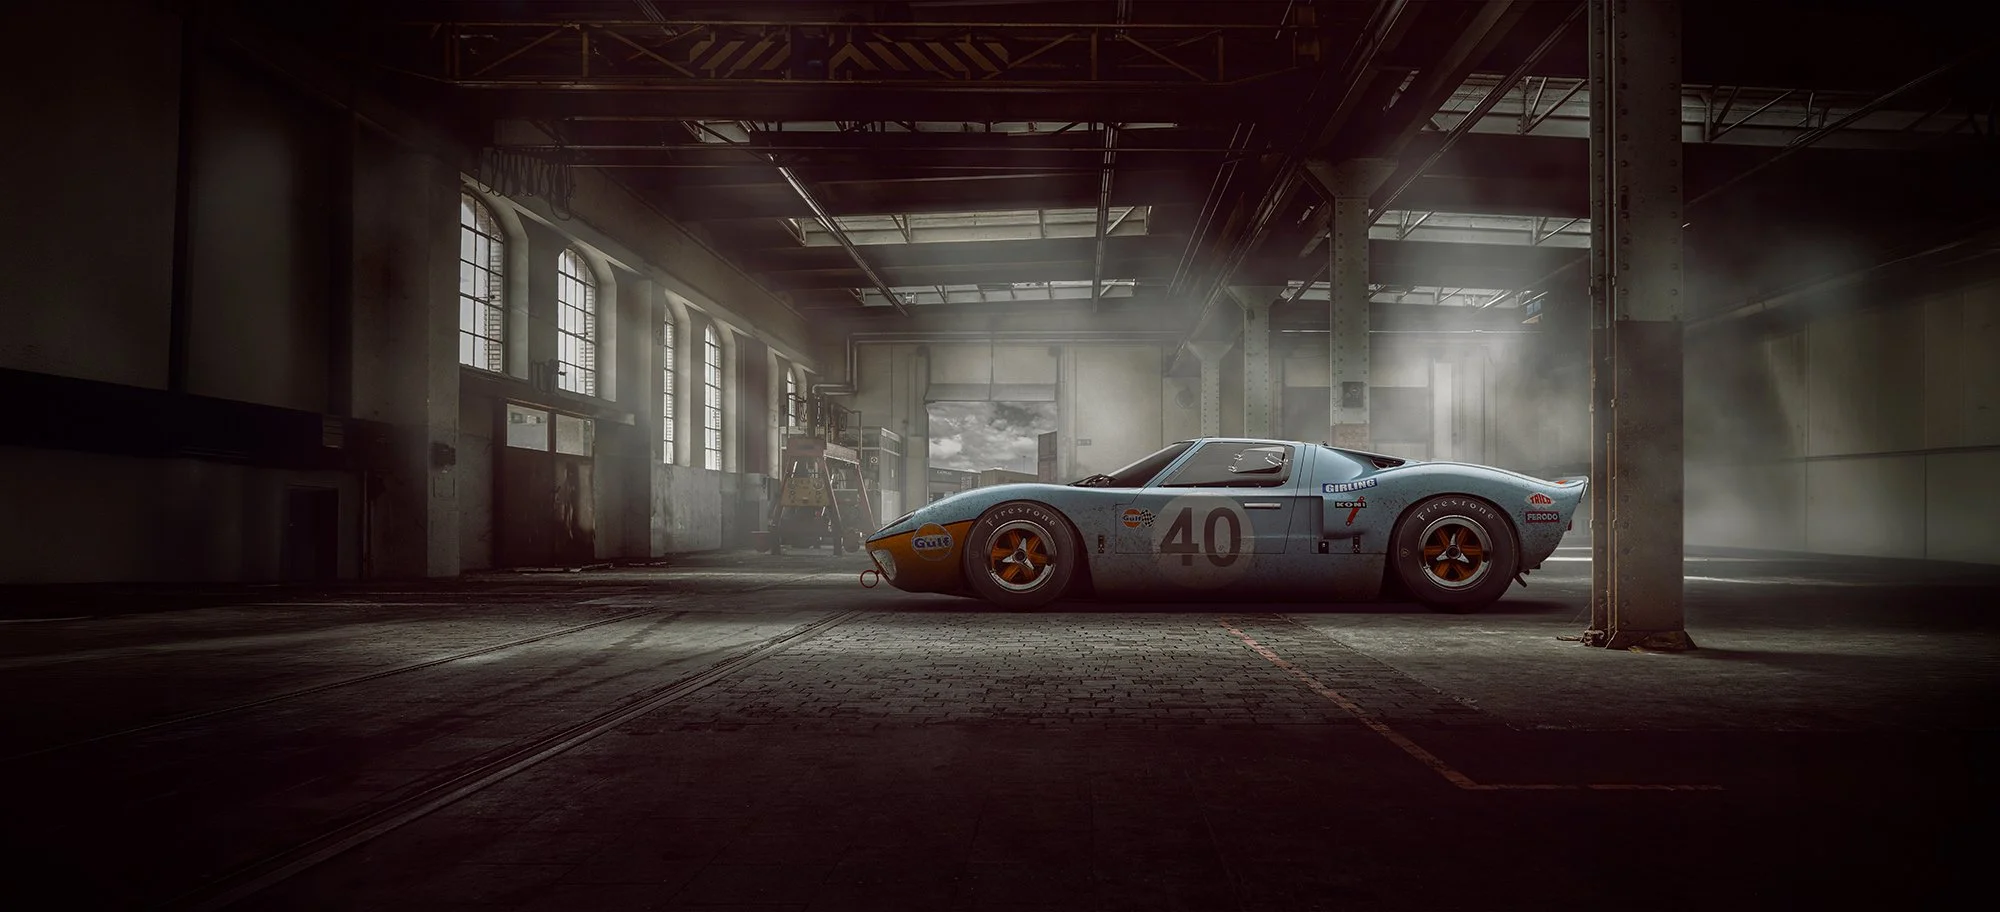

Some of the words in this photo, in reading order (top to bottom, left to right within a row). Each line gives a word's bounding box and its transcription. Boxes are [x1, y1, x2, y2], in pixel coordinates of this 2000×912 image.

[1325, 479, 1375, 493] GIRLING
[986, 506, 1056, 527] Firestone
[1122, 514, 1142, 522] Gulf
[1416, 500, 1495, 521] Firestone
[914, 535, 951, 548] Gulf
[1161, 507, 1241, 567] 40
